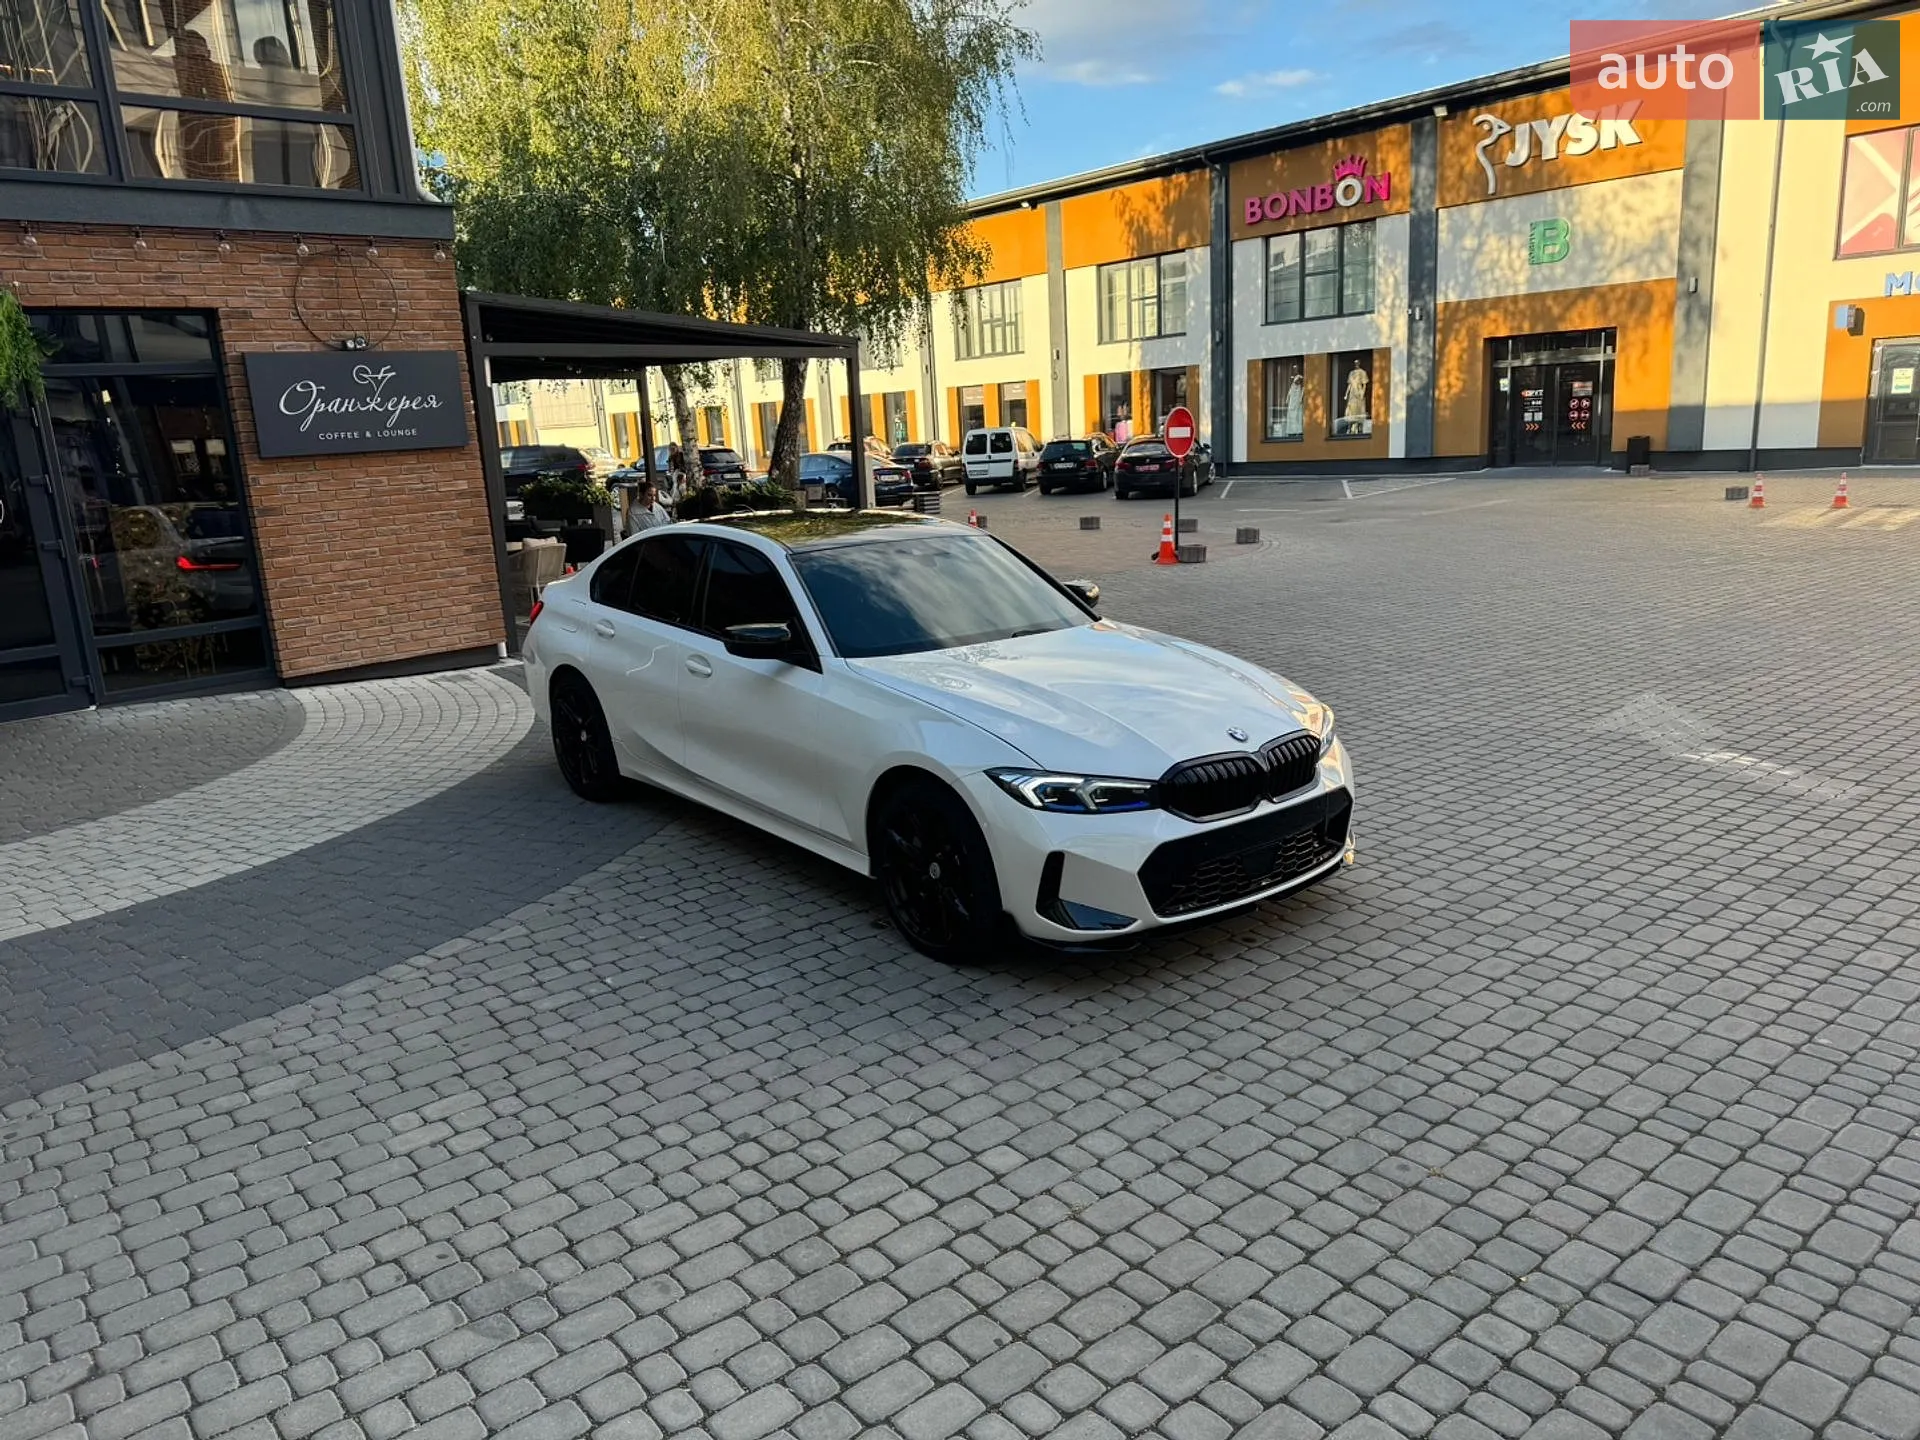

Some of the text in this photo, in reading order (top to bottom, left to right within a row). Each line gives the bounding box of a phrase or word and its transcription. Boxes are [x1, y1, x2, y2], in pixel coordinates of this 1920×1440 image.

[1504, 99, 1644, 167] JYSK
[1245, 172, 1391, 226] BONBON
[1884, 271, 1920, 297] M
[279, 379, 444, 432] Оранжерея
[318, 427, 418, 441] COFFEE & LOUNGE
